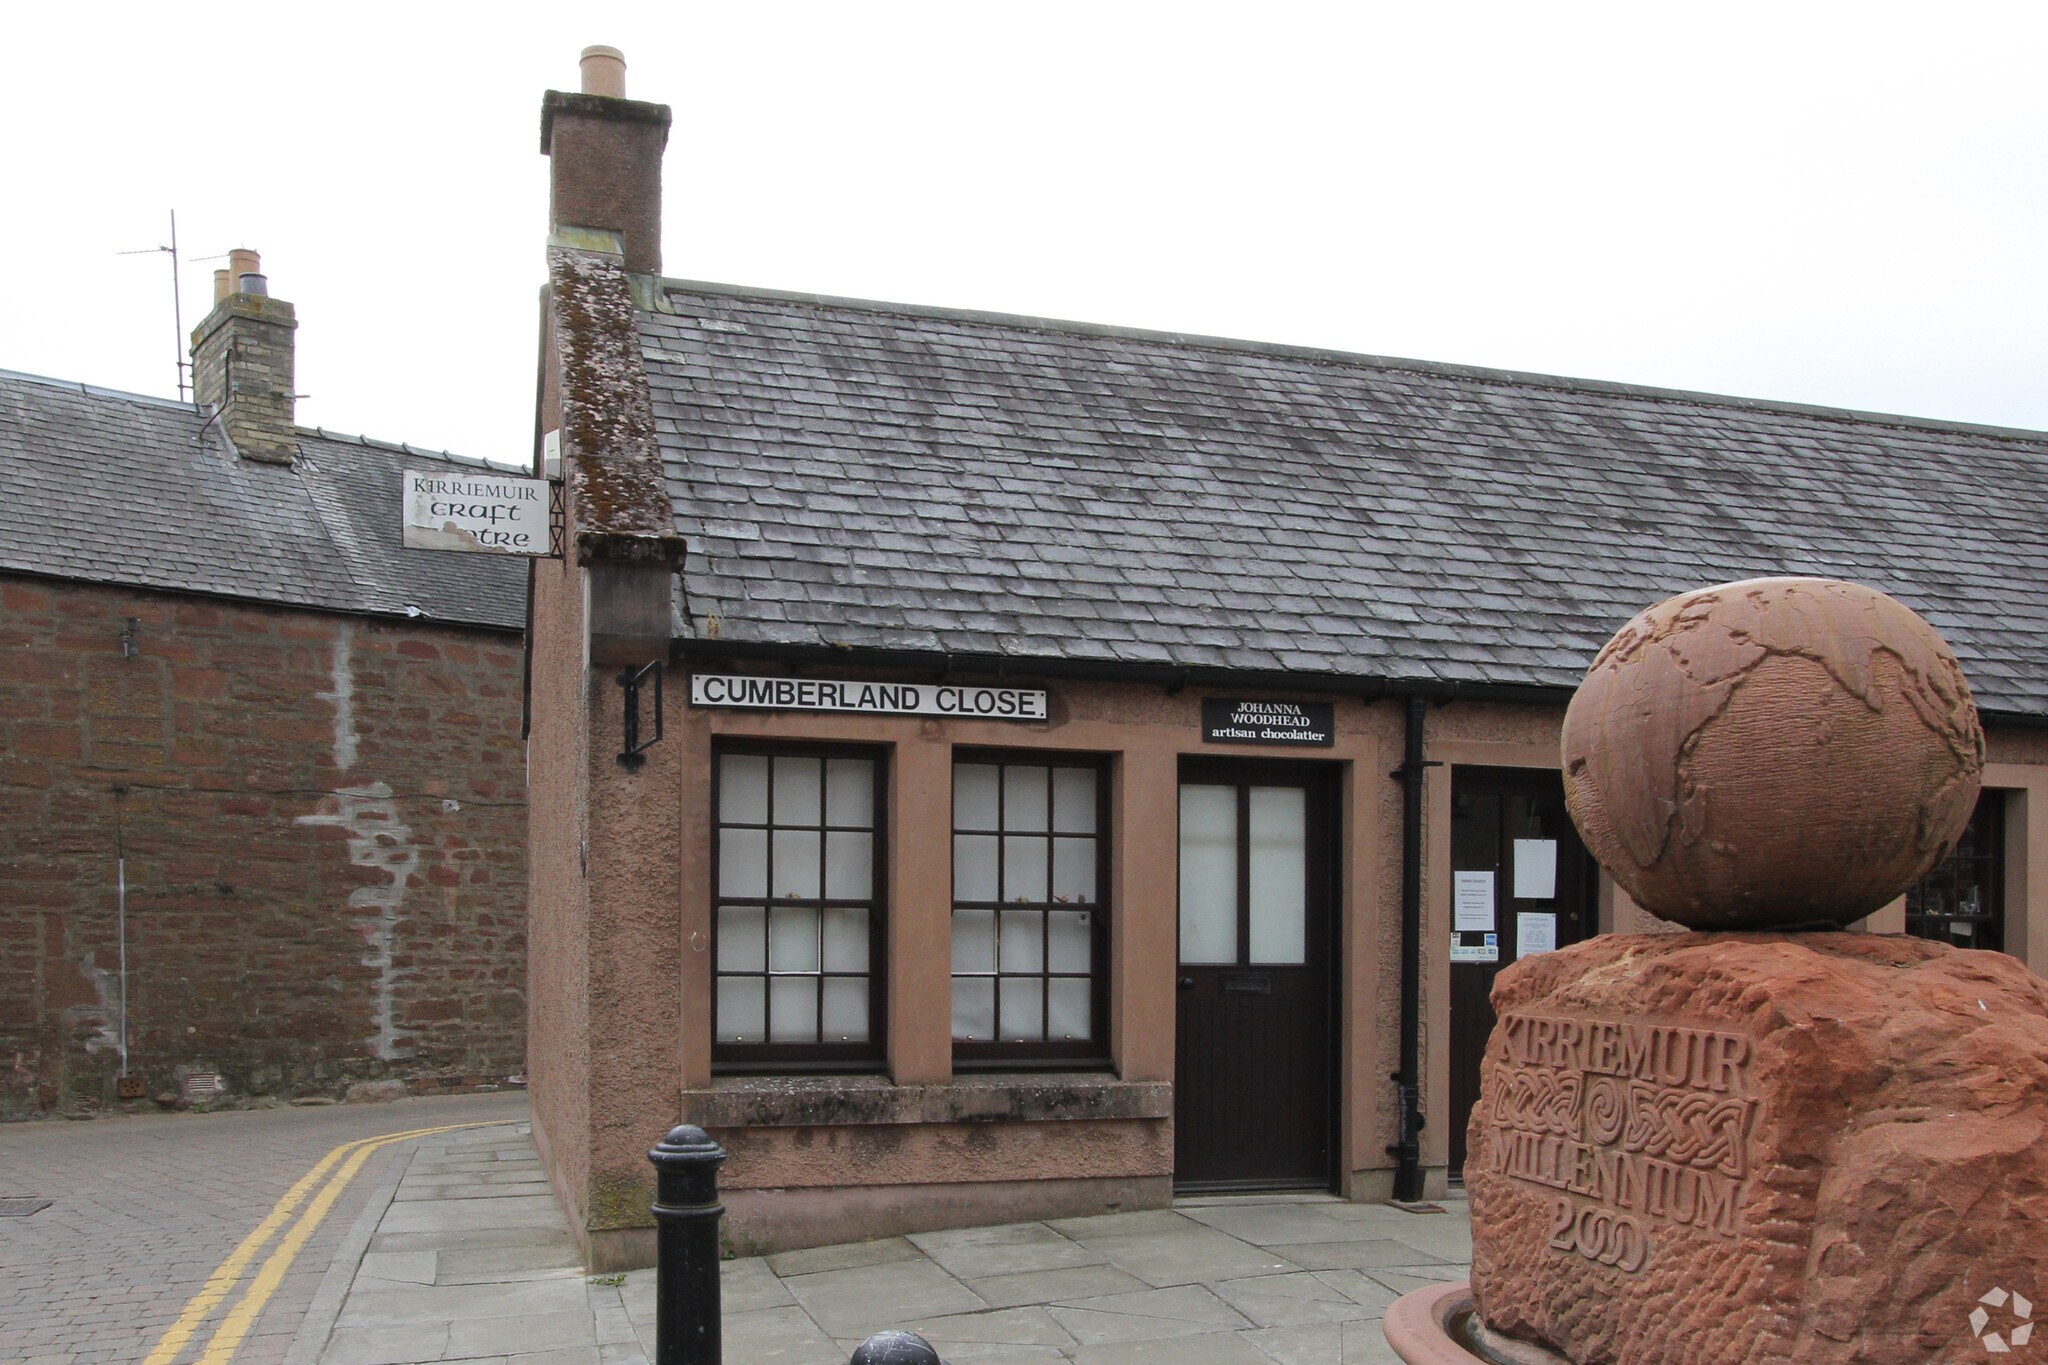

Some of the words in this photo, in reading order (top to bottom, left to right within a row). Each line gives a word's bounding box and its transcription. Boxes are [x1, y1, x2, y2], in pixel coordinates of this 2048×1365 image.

[413, 478, 539, 501] KIRRIEMUIR
[703, 676, 920, 711] CUMBERLAND
[935, 687, 1036, 716] CLOSE
[1238, 702, 1302, 715] JOHANNA
[1212, 728, 1257, 739] artisan
[1261, 728, 1325, 741] chocolatier
[1231, 713, 1311, 727] WOODHEAD
[1499, 1014, 1749, 1092] KIRRIEMUIR
[1491, 1131, 1741, 1238] MILLENNIUM
[1550, 1197, 1648, 1273] 2000
